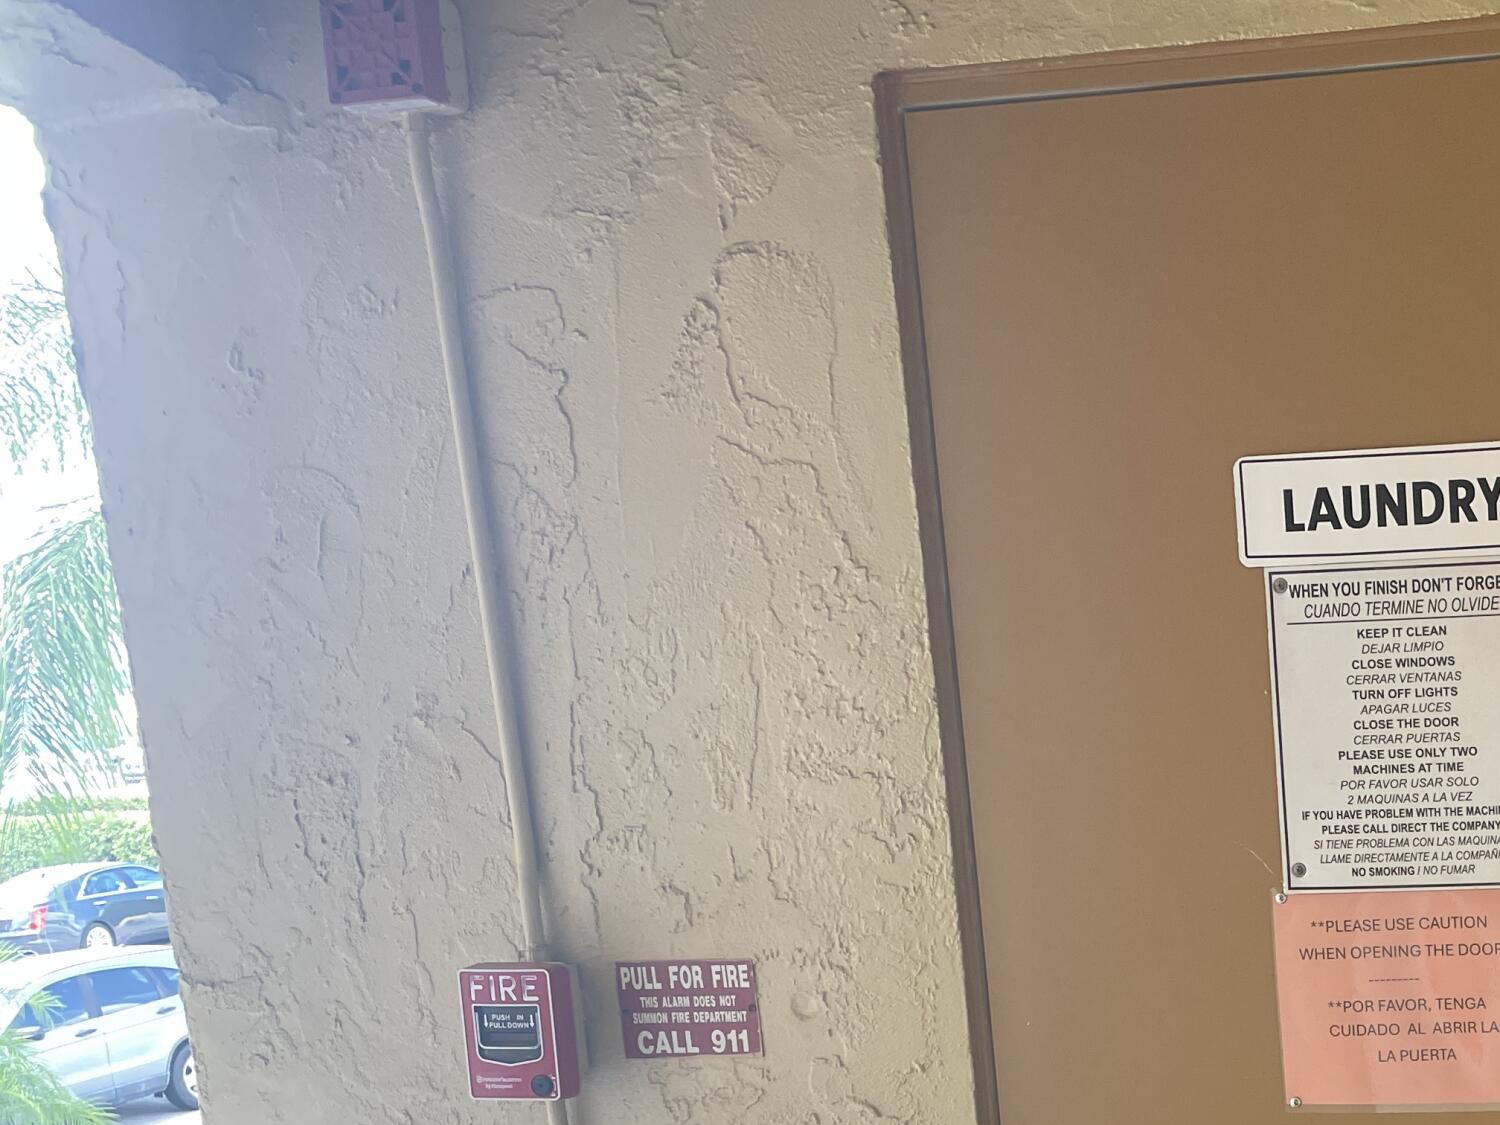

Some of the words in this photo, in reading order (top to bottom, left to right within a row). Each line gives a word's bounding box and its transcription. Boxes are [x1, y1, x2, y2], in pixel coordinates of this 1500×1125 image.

[1289, 583, 1329, 598] WHEN
[1332, 582, 1360, 597] YOU
[1365, 579, 1408, 595] FINISH
[1412, 578, 1452, 593] DON'T
[1304, 603, 1360, 618] CUANDO
[1365, 600, 1424, 616] TERMINE
[1428, 599, 1447, 613] NO
[1451, 596, 1500, 612] OLVIDE
[1357, 628, 1389, 639] KEEP
[1392, 628, 1402, 637] IT
[1406, 626, 1447, 637] CLEAN
[1362, 643, 1400, 654] DEJAR
[1403, 641, 1444, 652] LIMPIO
[1352, 659, 1392, 669] CLOSE
[1395, 656, 1455, 668] WINDOWS
[1346, 674, 1395, 685] CERRAR
[1400, 671, 1462, 683] VENTANAS
[1352, 690, 1384, 700] TURN
[1389, 689, 1411, 698] OFF
[1415, 687, 1458, 698] LIGHTS
[1360, 704, 1409, 715] APAGAR
[1412, 702, 1451, 713] LUCES
[1354, 719, 1393, 729] CLOSE
[1397, 719, 1420, 728] THE
[1424, 717, 1459, 727] DOOR
[1354, 734, 1403, 745] CERRAR
[1406, 732, 1461, 743] PUERTAS
[1338, 750, 1384, 760] PLEASE
[1388, 749, 1412, 759] USE
[1416, 748, 1447, 758] ONLY
[1452, 747, 1478, 756] TWO
[1353, 764, 1415, 775] MACHINES
[1418, 763, 1432, 772] AT
[1436, 762, 1464, 772] TIME
[1340, 780, 1365, 790] POR
[1369, 779, 1407, 789] FAVOR
[1411, 778, 1443, 788] USAR
[1446, 777, 1479, 786] SOLO
[1348, 795, 1354, 805] 2
[1357, 793, 1418, 805] MAQUINAS
[1421, 794, 1429, 803] A
[1432, 793, 1446, 802] LA
[1450, 792, 1473, 801] VEZ
[1302, 812, 1310, 820] IF
[1313, 811, 1334, 820] YOU
[1337, 810, 1362, 819] HAVE
[1365, 808, 1413, 819] PROBLEM
[1416, 807, 1441, 817] WITH
[1444, 807, 1463, 816] THE
[1322, 825, 1360, 834] PLEASE
[1363, 824, 1388, 833] CALL
[1392, 823, 1427, 832] DIRECT
[1430, 822, 1449, 831] THE
[1452, 821, 1500, 831] COMPANY
[1314, 840, 1323, 849] SI
[1326, 840, 1353, 849] TIENE
[1356, 838, 1409, 848] PROBLEMA
[1413, 838, 1433, 847] CON
[1437, 837, 1454, 846] LAS
[1320, 855, 1351, 864] LLAME
[1354, 852, 1429, 863] DIRECTAMENTE
[1432, 853, 1438, 861] A
[1441, 852, 1453, 860] LA
[1352, 868, 1366, 877] NO
[1369, 866, 1415, 876] SMOKING
[1423, 866, 1438, 875] NO
[1440, 864, 1475, 874] FUMAR
[1385, 918, 1414, 931] USE
[1419, 916, 1488, 929] CAUTION
[1299, 948, 1346, 960] WHEN
[1351, 945, 1421, 959] OPENING
[1425, 944, 1454, 956] THE
[620, 966, 662, 990] PULL
[668, 965, 704, 989] FOR
[711, 964, 750, 988] FIRE
[470, 975, 539, 1001] FIRE
[640, 997, 658, 1008] THIS
[662, 996, 690, 1007] ALARM
[693, 996, 716, 1007] DOES
[720, 995, 735, 1006] NOT
[1378, 999, 1432, 1012] FAVOR,
[1436, 997, 1486, 1010] TENGA
[633, 1012, 668, 1024] SUMMON
[672, 1012, 690, 1023] FIRE
[694, 1011, 747, 1022] DEPARTMENT
[1329, 1024, 1400, 1037] CUIDADO
[1408, 1023, 1426, 1035] AL
[1433, 1022, 1477, 1033] ABRIR
[1481, 1021, 1499, 1032] LA
[638, 1031, 699, 1054] CALL
[711, 1029, 749, 1053] 911
[1378, 1051, 1396, 1062] LA
[1400, 1049, 1456, 1061] PUERTA
